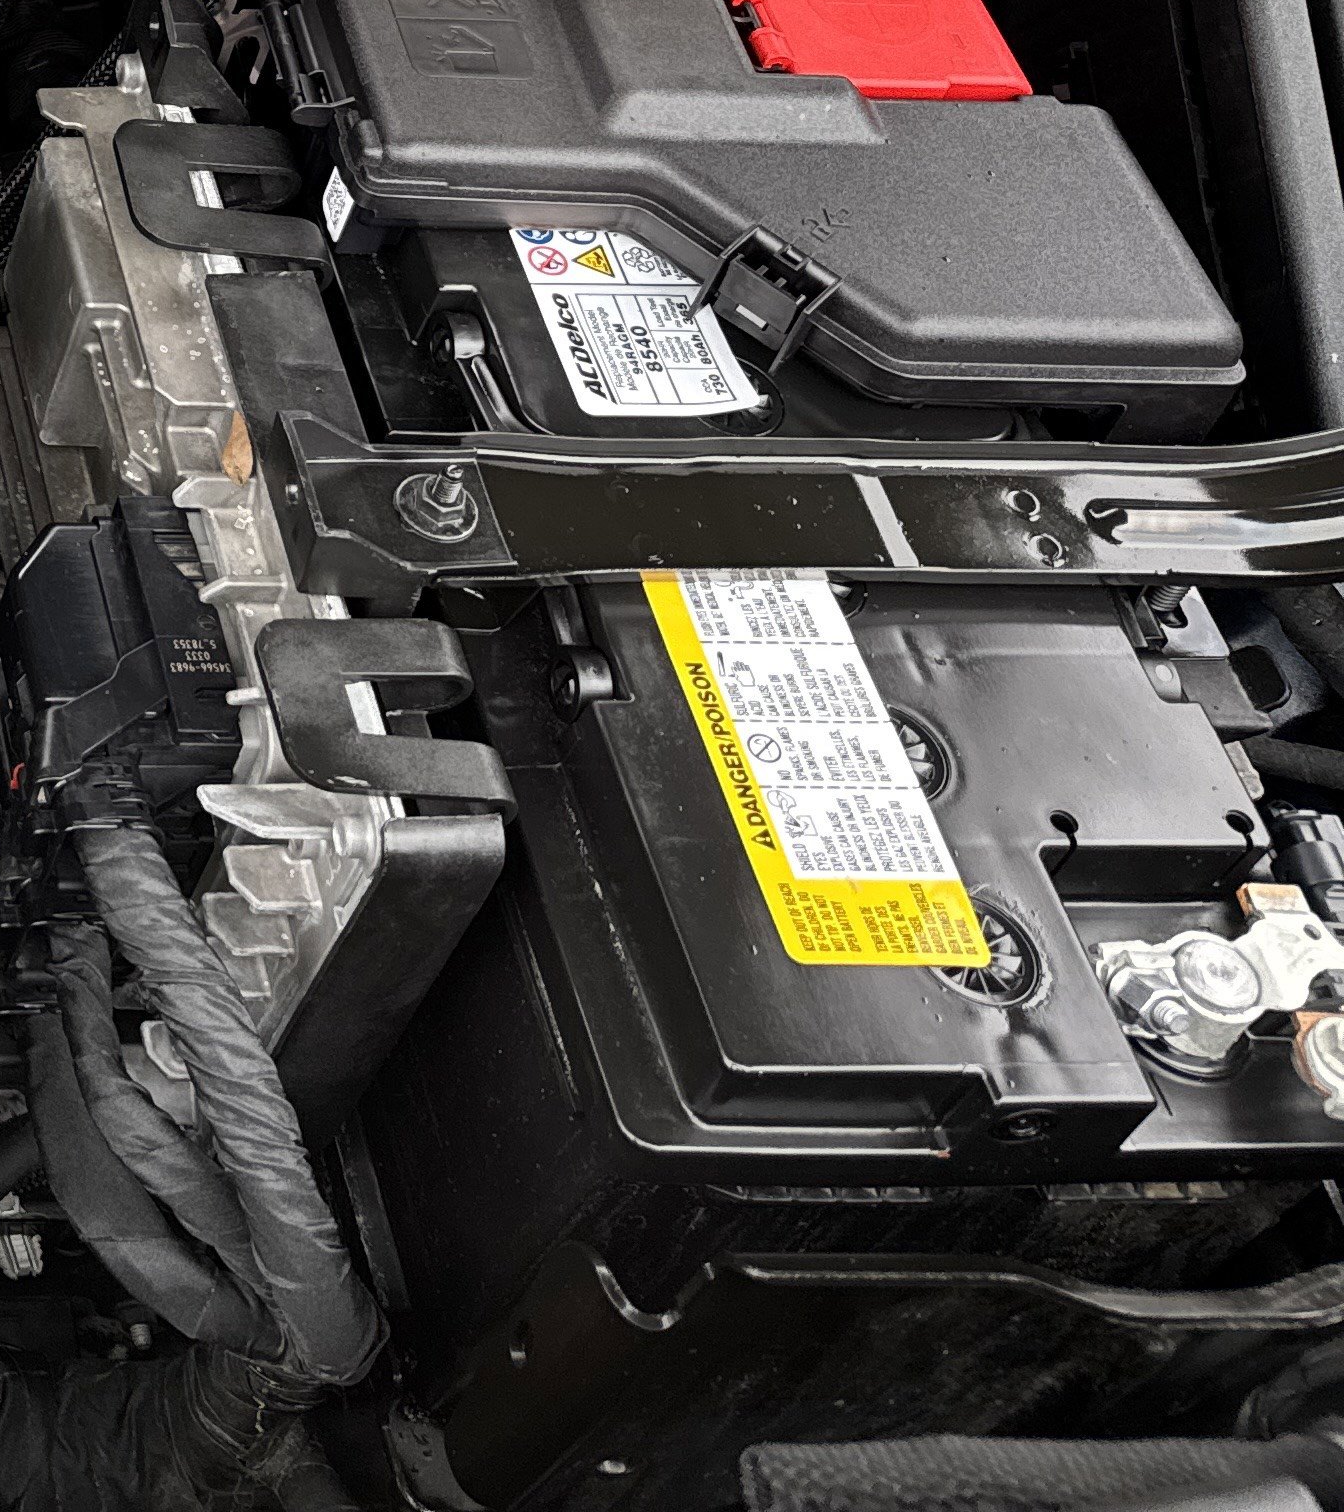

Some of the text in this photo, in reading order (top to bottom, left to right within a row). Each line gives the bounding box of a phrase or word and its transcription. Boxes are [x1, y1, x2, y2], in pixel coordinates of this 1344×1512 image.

[552, 293, 606, 398] ACDelco
[612, 323, 643, 374] 94RAGM
[630, 326, 663, 372] 8540
[691, 334, 712, 364] 80Ah
[708, 374, 727, 395] 730
[686, 663, 765, 826] DANGER/POISON
[777, 770, 793, 780] NO
[845, 769, 861, 782] LES
[861, 770, 876, 782] LES
[852, 794, 871, 814] YEUX
[826, 811, 845, 832] CAUSE
[862, 816, 879, 830] LES
[837, 834, 851, 847] CAN
[792, 843, 815, 871] SHIELD
[812, 852, 831, 871] EYES
[898, 859, 913, 872] LES
[796, 891, 811, 901] DO
[812, 894, 828, 908] NOT
[778, 882, 816, 951] KEEP OUT OF REACH
[819, 910, 834, 920] DO
[817, 942, 831, 951] OF
[830, 937, 846, 951] NOT
[844, 933, 862, 952] OPEN
[890, 944, 904, 953] LA
